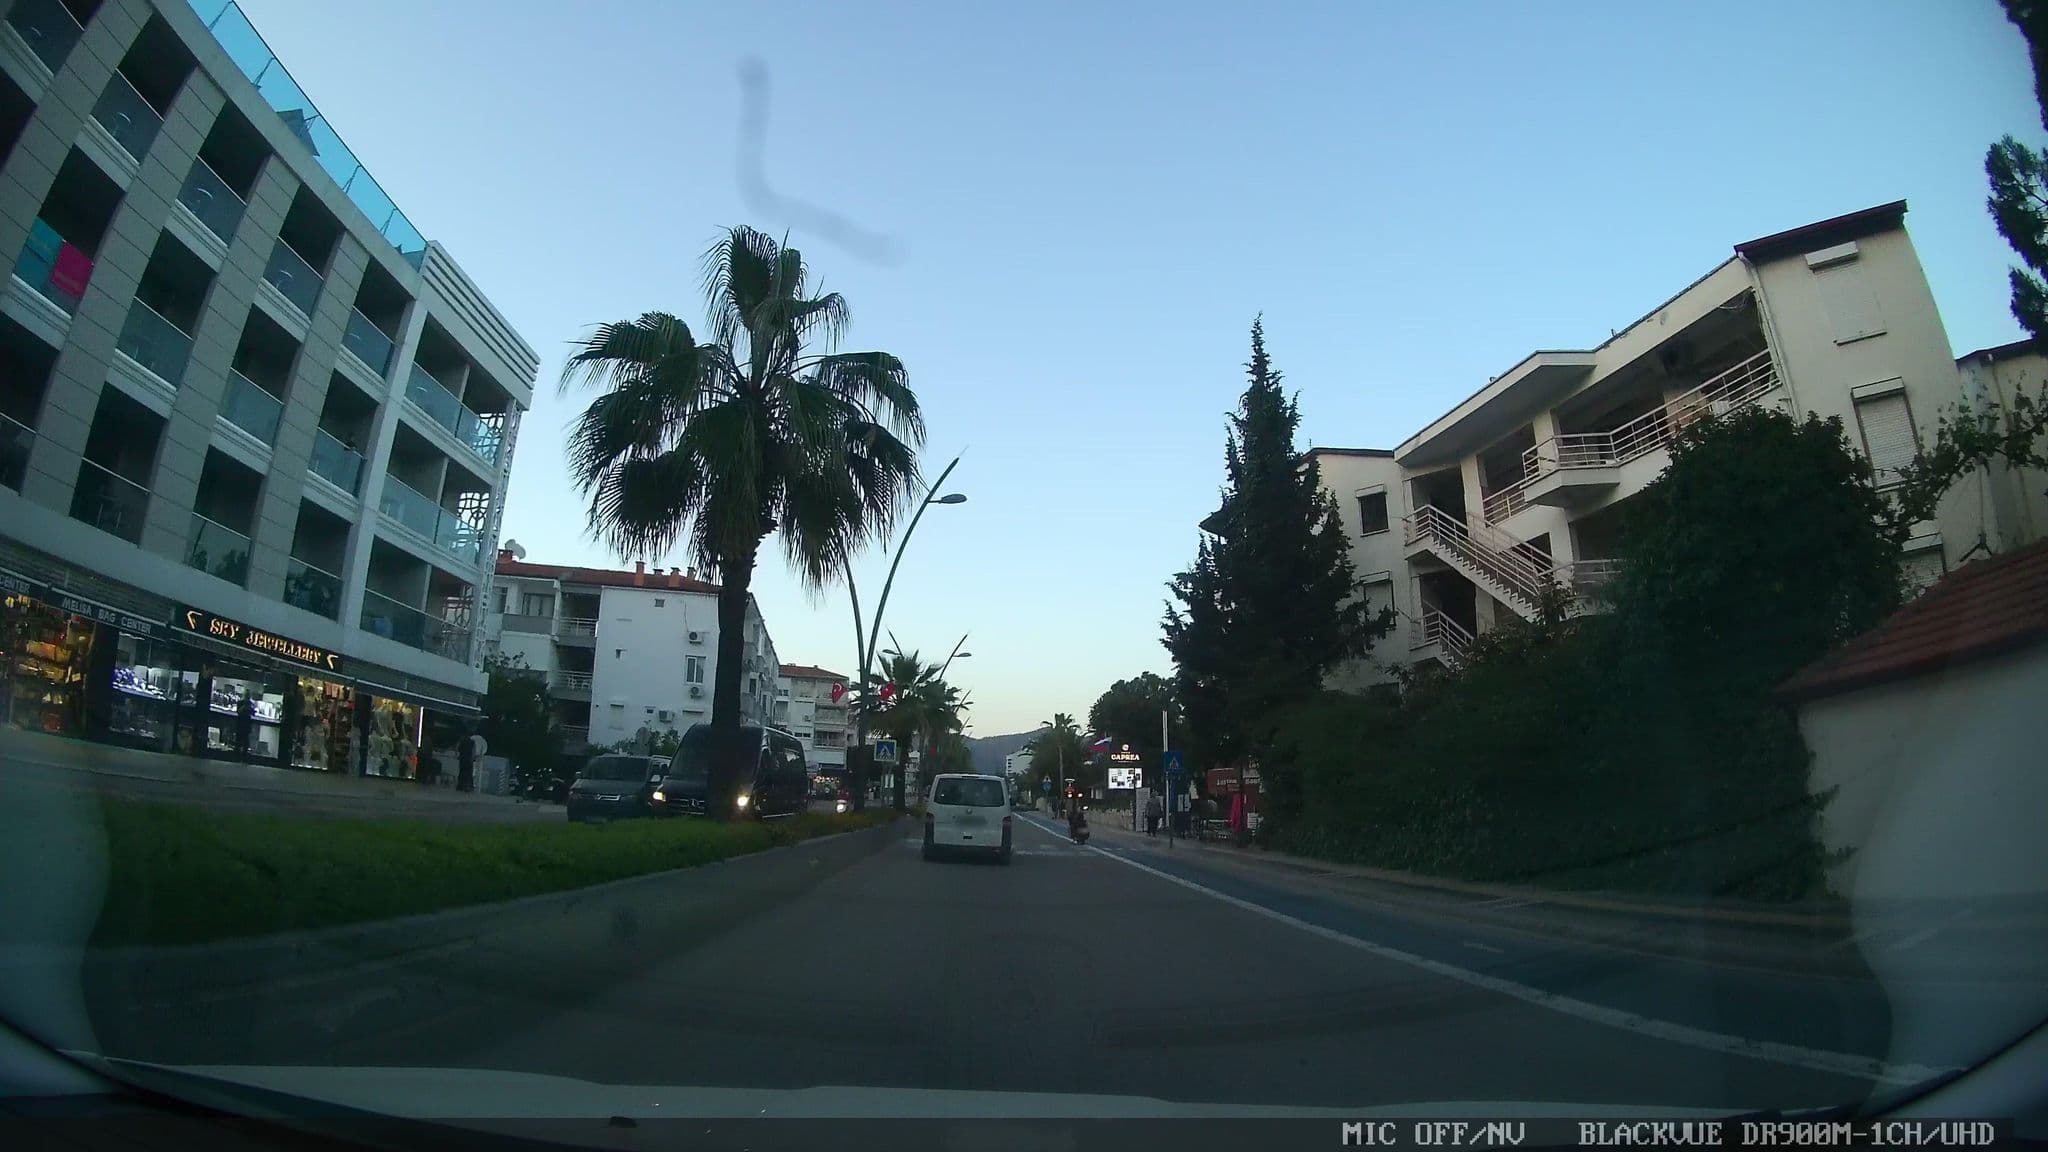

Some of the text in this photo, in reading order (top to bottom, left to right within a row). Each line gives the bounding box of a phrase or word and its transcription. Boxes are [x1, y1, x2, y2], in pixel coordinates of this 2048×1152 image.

[98, 608, 116, 623] BAG
[121, 615, 152, 634] CENTER
[210, 618, 321, 663] SKY JEWELLERY
